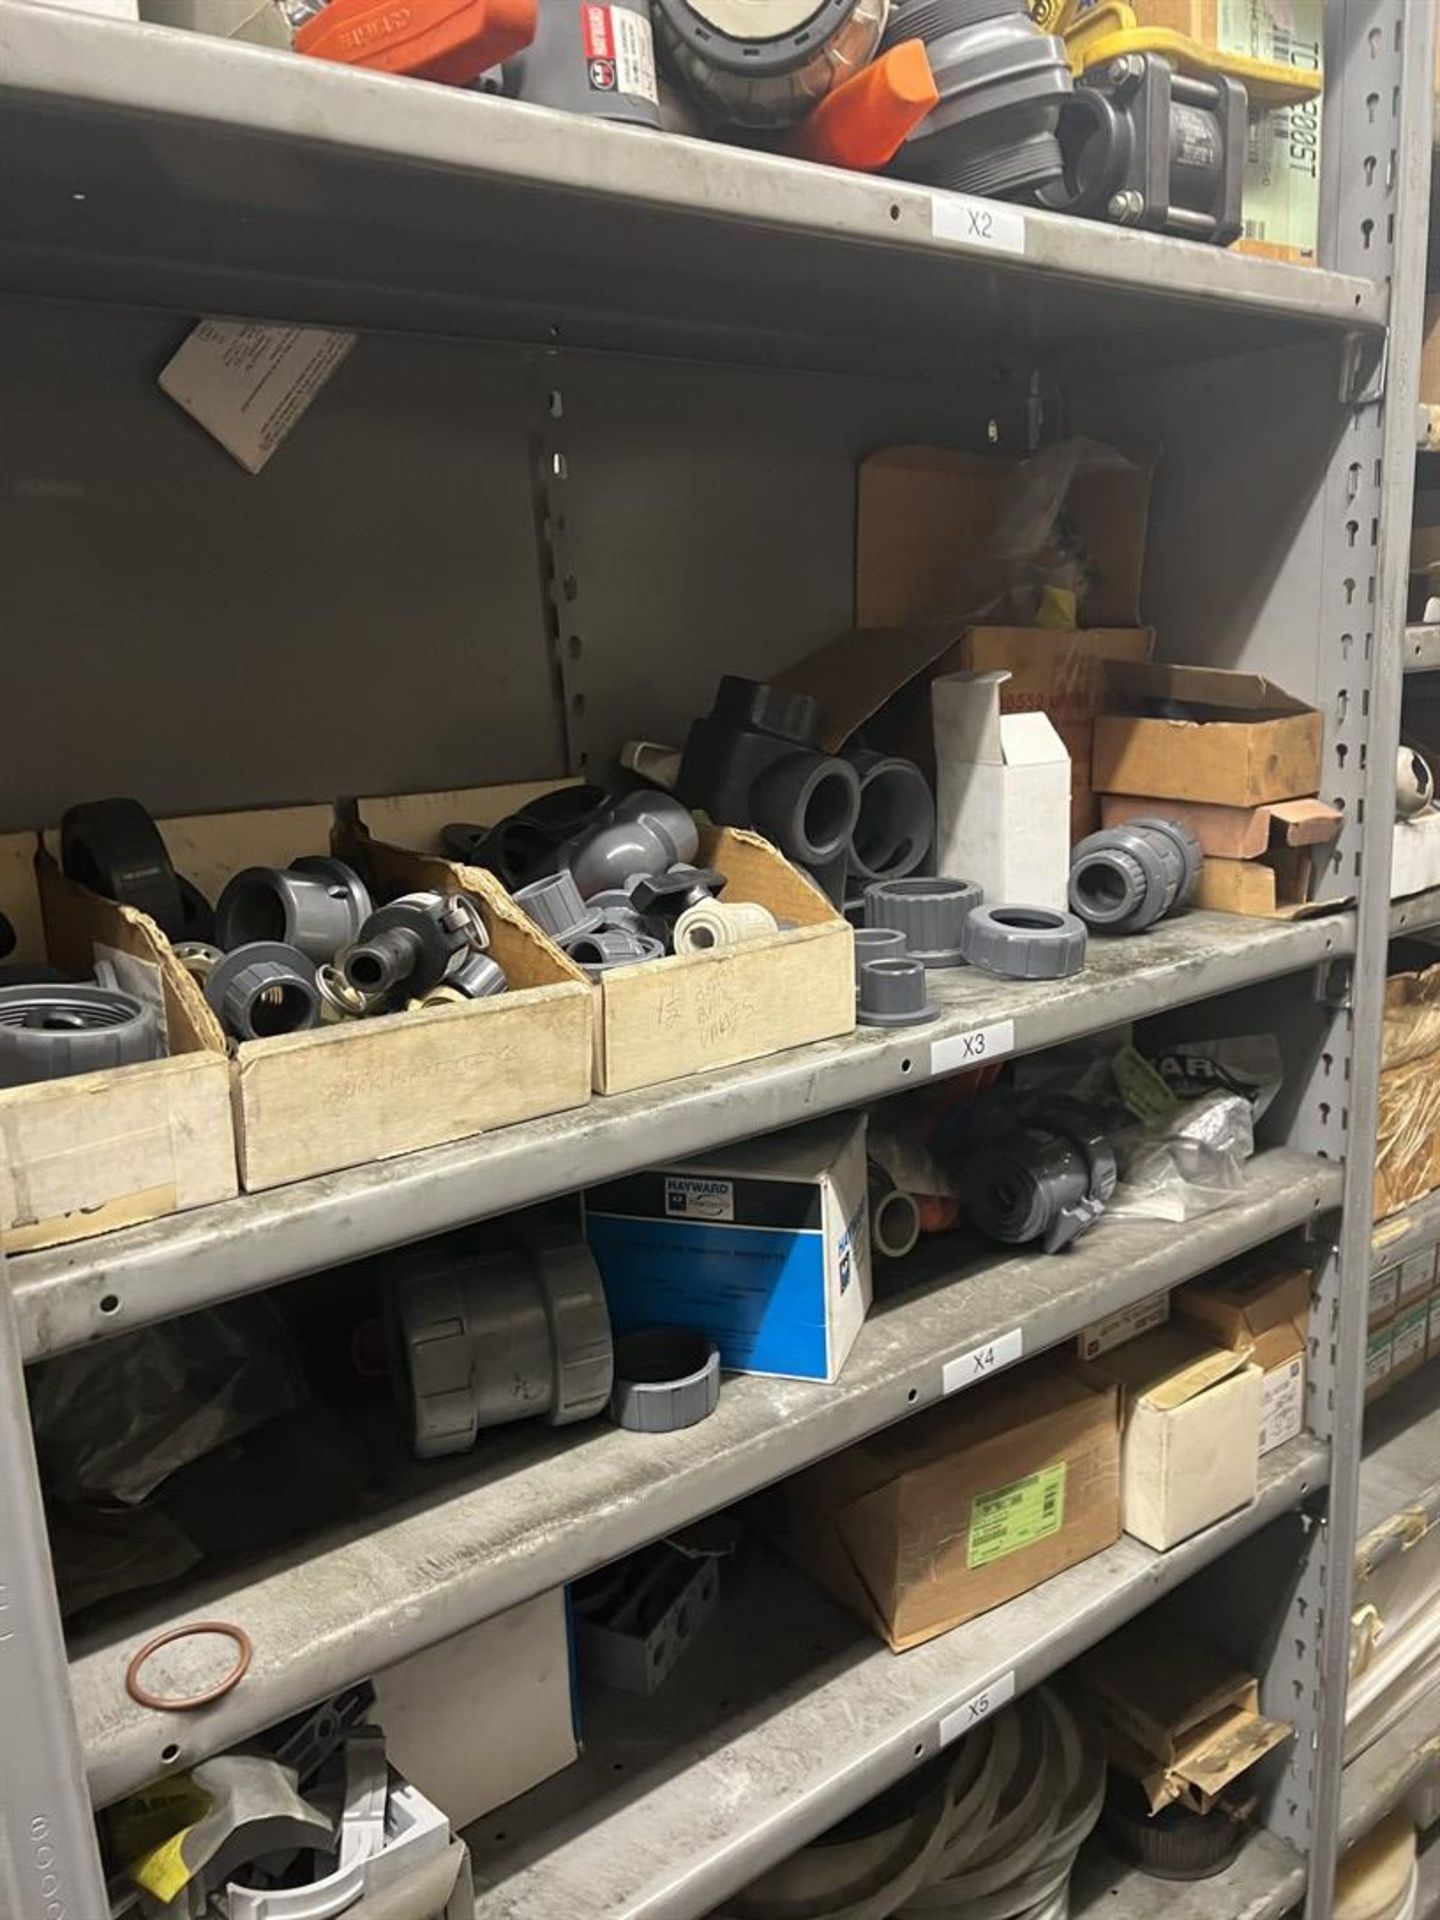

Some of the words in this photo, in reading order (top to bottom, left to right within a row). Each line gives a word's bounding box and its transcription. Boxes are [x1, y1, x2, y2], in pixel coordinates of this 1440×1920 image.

[967, 208, 993, 239] X2
[962, 1033, 986, 1058] X3
[667, 1181, 729, 1195] HAYWARD
[973, 1347, 995, 1373] X4
[968, 1692, 989, 1723] X5
